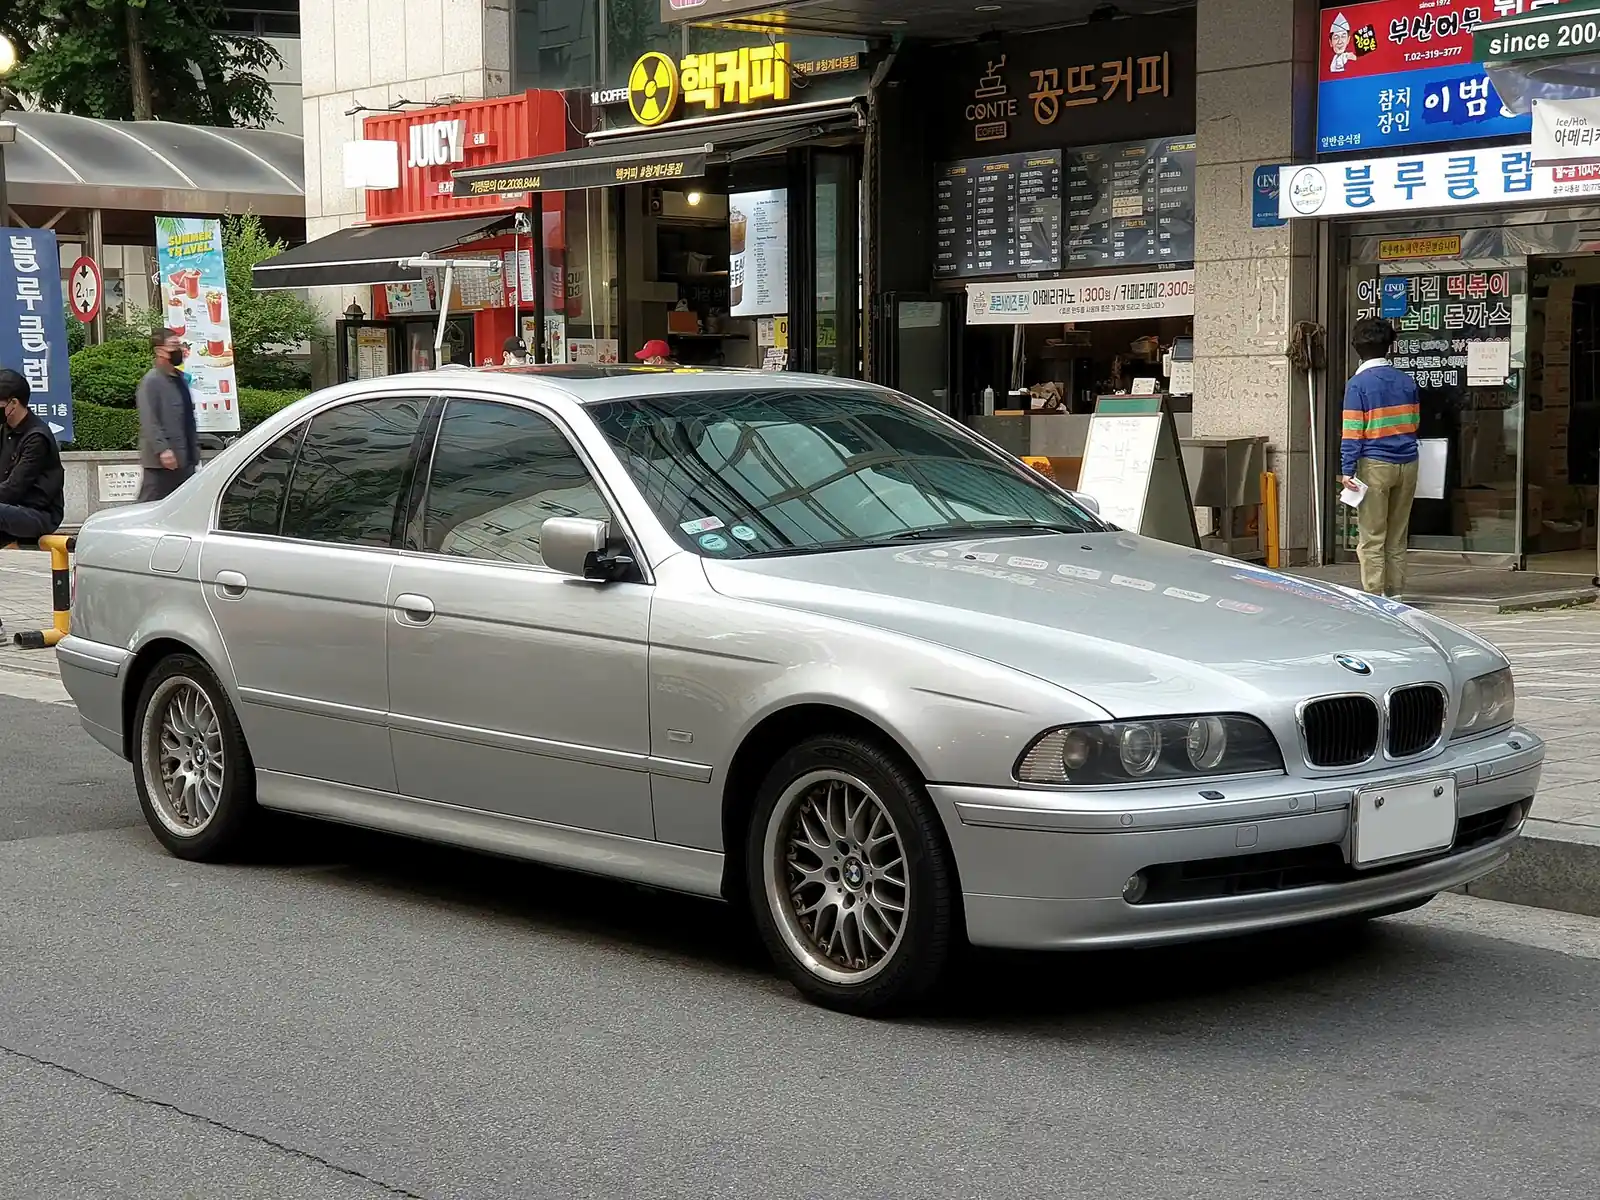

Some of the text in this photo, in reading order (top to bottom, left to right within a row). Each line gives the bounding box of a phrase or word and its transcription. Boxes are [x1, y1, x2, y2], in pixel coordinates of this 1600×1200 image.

[1419, 1, 1435, 9] since
[1489, 22, 1600, 55] since 200
[1404, 47, 1463, 62] T.02-319-3777
[680, 42, 791, 110] 핵커피
[600, 88, 629, 103] COFFE
[1028, 51, 1170, 125] 꽁뜨커피
[1378, 76, 1517, 118] 참치 이범
[965, 99, 1018, 121] CONTE
[978, 125, 1004, 136] COFFEE
[1377, 111, 1410, 134] 장인
[1556, 117, 1588, 127] Ice/Hot
[408, 119, 466, 168] JUICY
[1321, 133, 1361, 148] 일반음식점
[1257, 173, 1280, 187] CESC
[1343, 152, 1534, 208] 블루클럽
[168, 231, 213, 247] SUMMER
[168, 242, 214, 257] TRAVEL
[75, 282, 95, 299] 2.1m
[1447, 271, 1510, 299] 떡볶이
[1032, 288, 1075, 306] 아메리카노
[9, 235, 50, 393] 블루클럽
[1400, 304, 1440, 331] 순대
[1444, 302, 1511, 329] 돈까스
[51, 403, 68, 417] 1층
